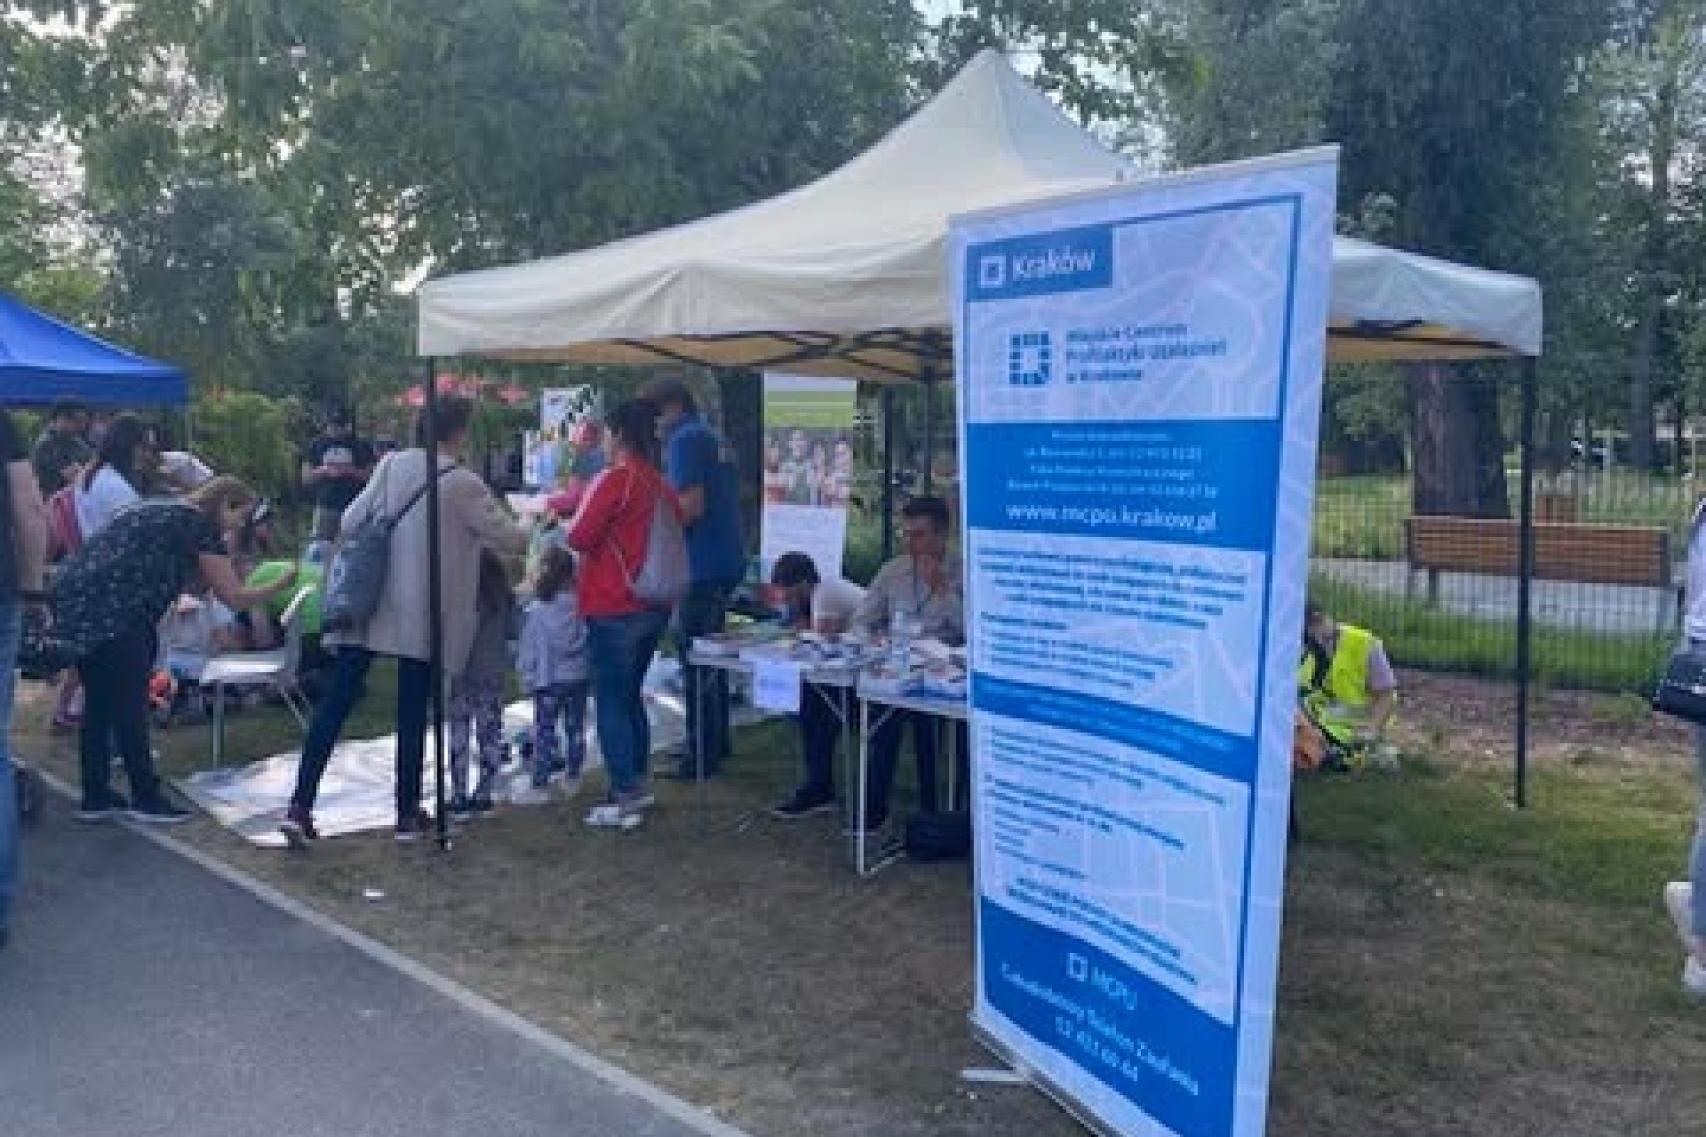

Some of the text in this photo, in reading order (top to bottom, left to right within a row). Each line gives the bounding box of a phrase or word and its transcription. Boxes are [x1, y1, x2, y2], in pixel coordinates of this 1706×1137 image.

[1012, 244, 1097, 282] Kraków
[1125, 323, 1188, 340] Centrum
[1006, 504, 1218, 534] www.mcpu.krakow.pl
